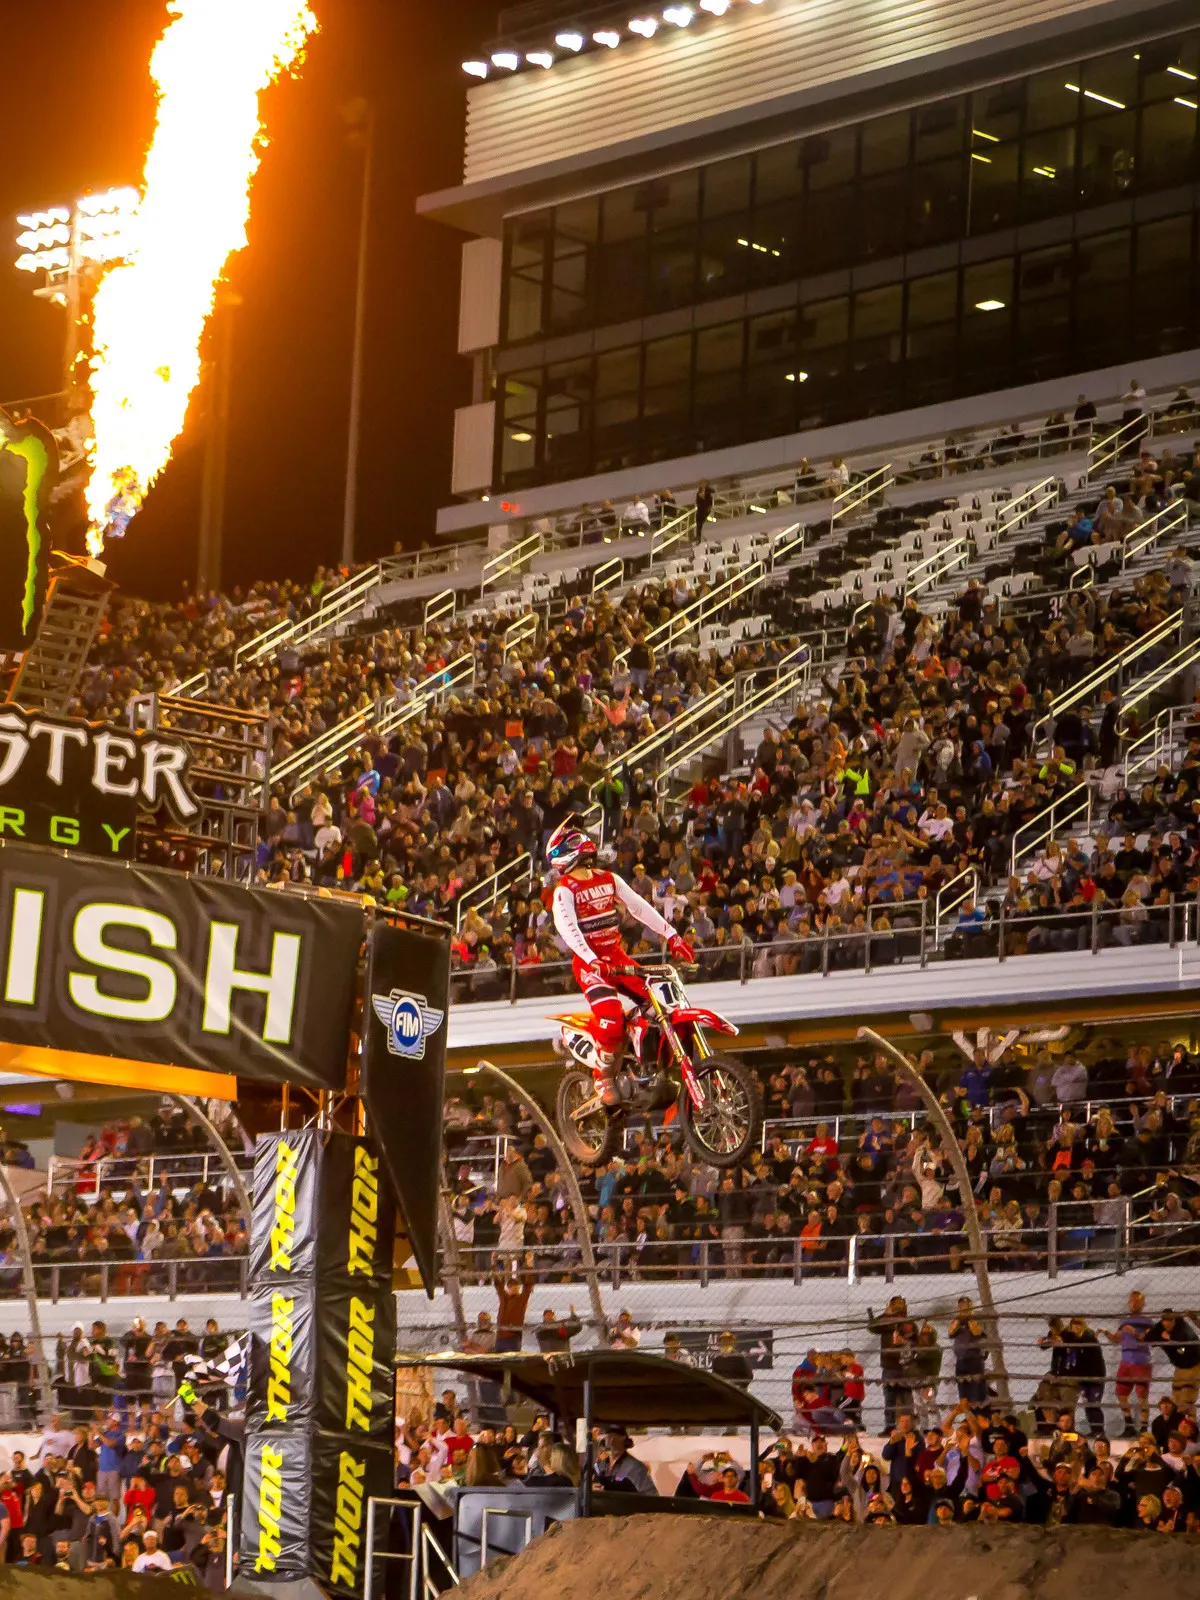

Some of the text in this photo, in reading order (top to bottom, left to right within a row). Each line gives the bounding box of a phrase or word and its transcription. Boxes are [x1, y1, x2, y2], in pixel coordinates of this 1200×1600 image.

[395, 1011, 419, 1037] FIM
[269, 1141, 299, 1272] THOR
[347, 1146, 379, 1277] THOR
[265, 1292, 294, 1422] THOR
[346, 1296, 376, 1432] THOR
[254, 1444, 284, 1573] THOR
[330, 1450, 366, 1588] THOR
